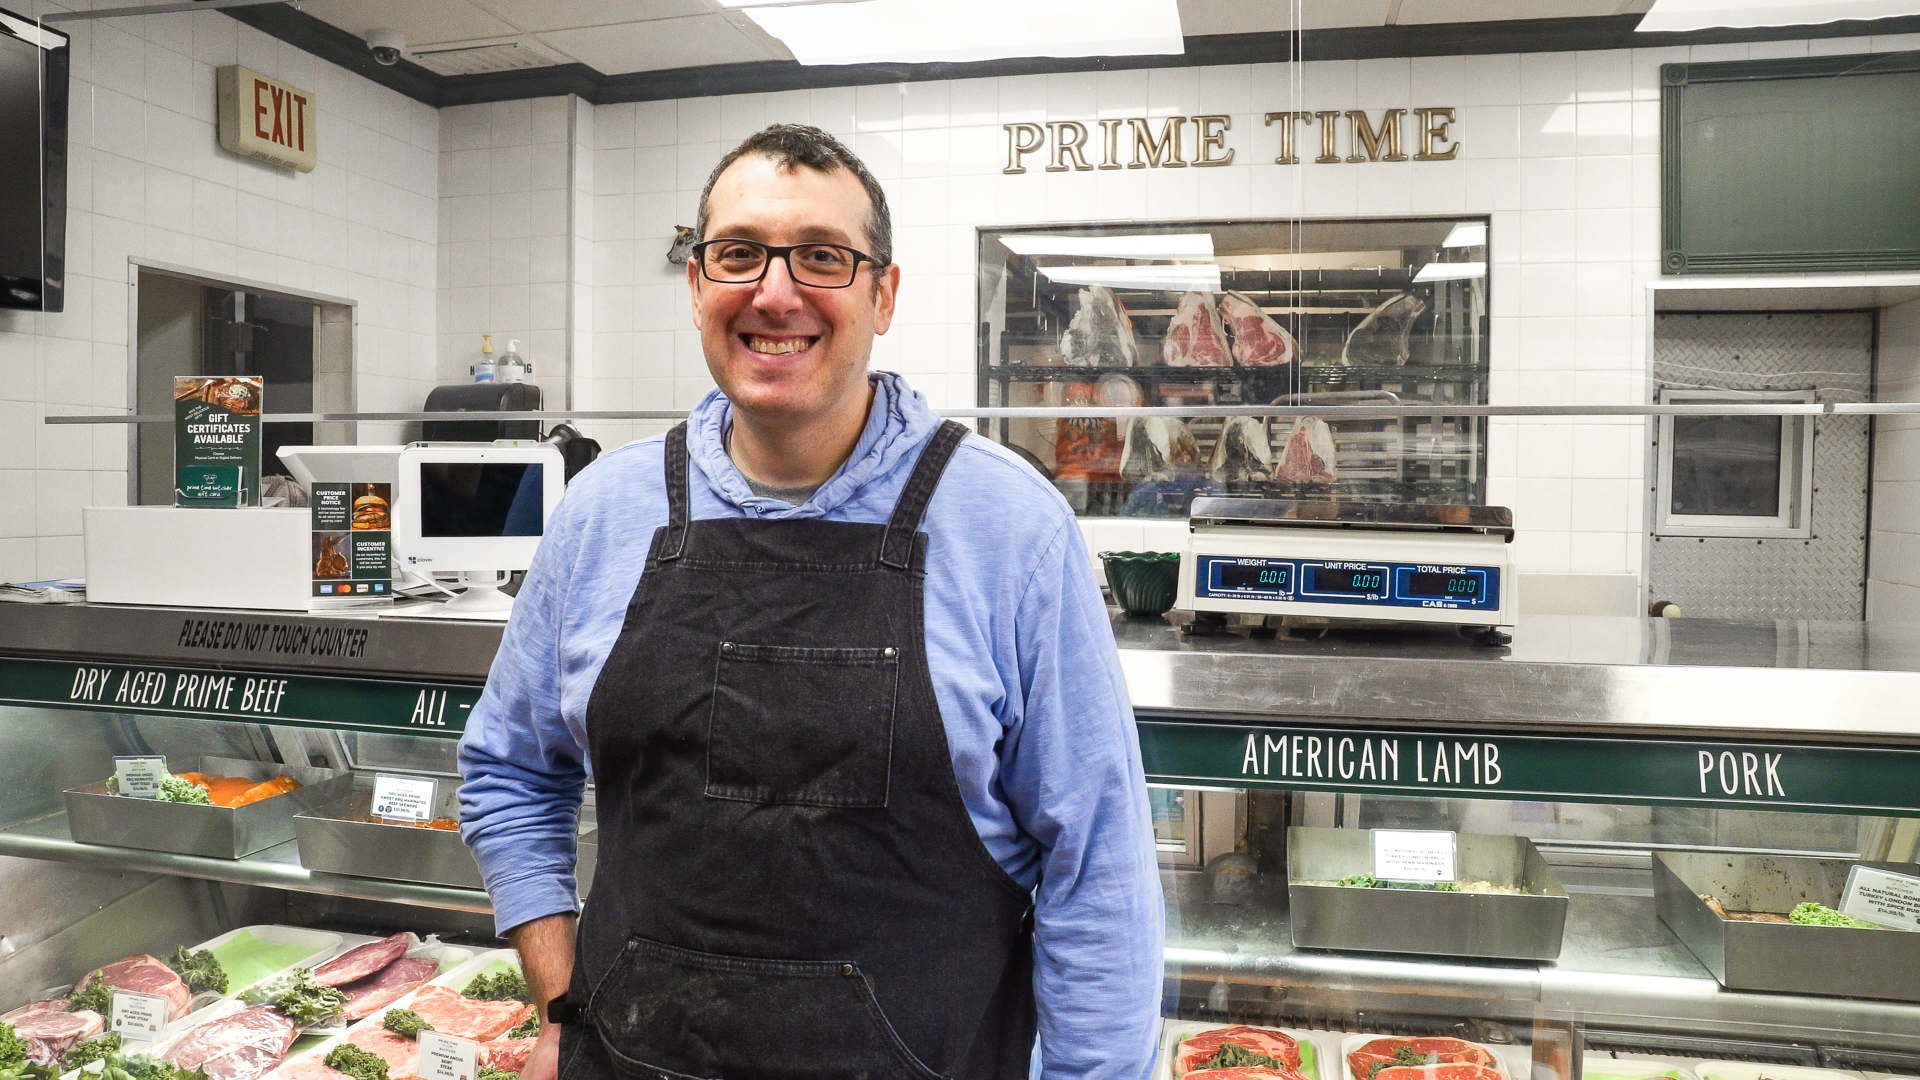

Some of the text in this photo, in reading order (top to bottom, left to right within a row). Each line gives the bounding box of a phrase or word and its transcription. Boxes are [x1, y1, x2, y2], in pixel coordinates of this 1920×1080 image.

[254, 78, 307, 152] EXIT
[1003, 107, 1461, 175] PRIME TIME
[208, 413, 229, 423] GIFT
[187, 423, 251, 434] CERTIFICATES
[193, 434, 244, 444] AVAILABLE
[1237, 558, 1267, 566] WEIGHT
[1324, 561, 1342, 569] UNIT
[1416, 565, 1442, 573] TOTAL
[1442, 566, 1467, 574] PRICE
[1259, 570, 1287, 584] 0.00
[1352, 574, 1380, 588] 0.00
[1447, 579, 1476, 593] 0.00
[1422, 600, 1443, 608] CAS
[177, 619, 369, 658] PLEASE DO NOT TOUCH COUNTER
[70, 667, 288, 713] DRY AGED PRIME BEEF
[410, 689, 447, 725] ALL
[1241, 733, 1502, 785] AMERICAN LAMB
[1698, 750, 1786, 797] PORK
[1860, 892, 1884, 900] TURKEY
[1884, 896, 1912, 906] LONDON
[1872, 888, 1902, 898] NATURAL
